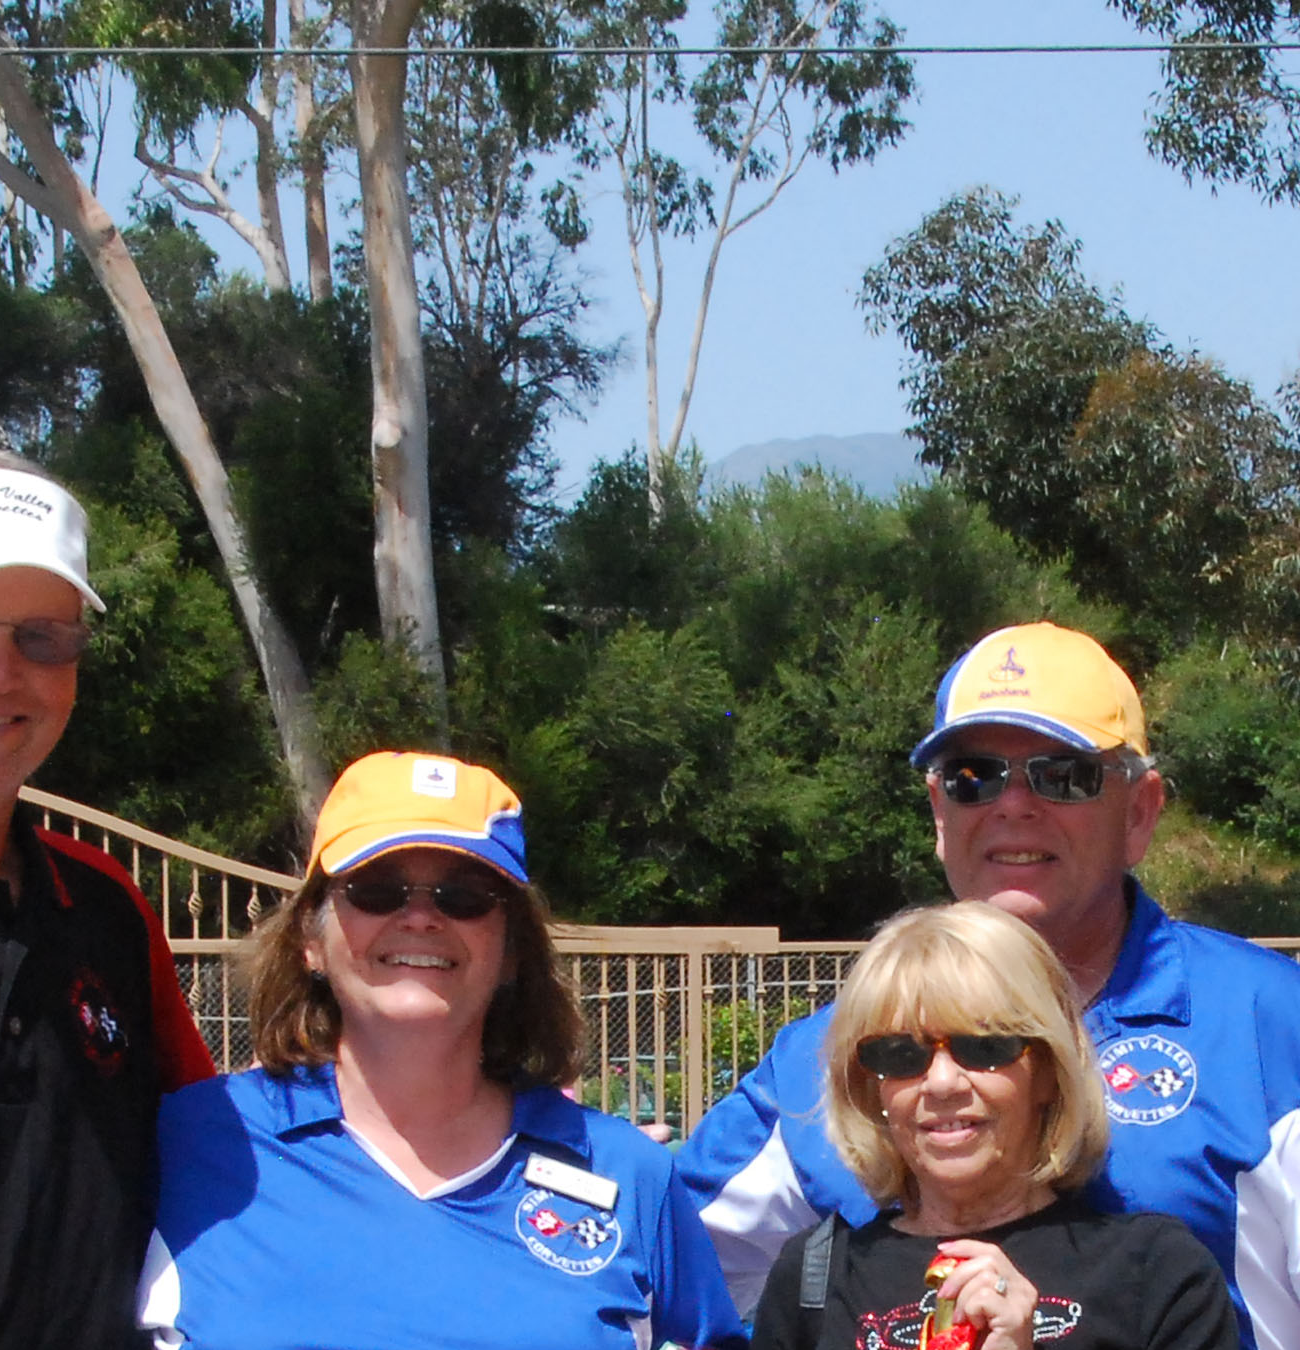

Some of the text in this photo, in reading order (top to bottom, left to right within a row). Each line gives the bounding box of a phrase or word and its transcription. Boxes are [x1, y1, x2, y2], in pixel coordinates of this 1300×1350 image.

[0, 486, 54, 514] Valley
[1101, 1040, 1193, 1077] SIMI VALLEY
[1104, 1095, 1176, 1121] ORVETTES
[528, 1236, 603, 1272] CORVETTES
